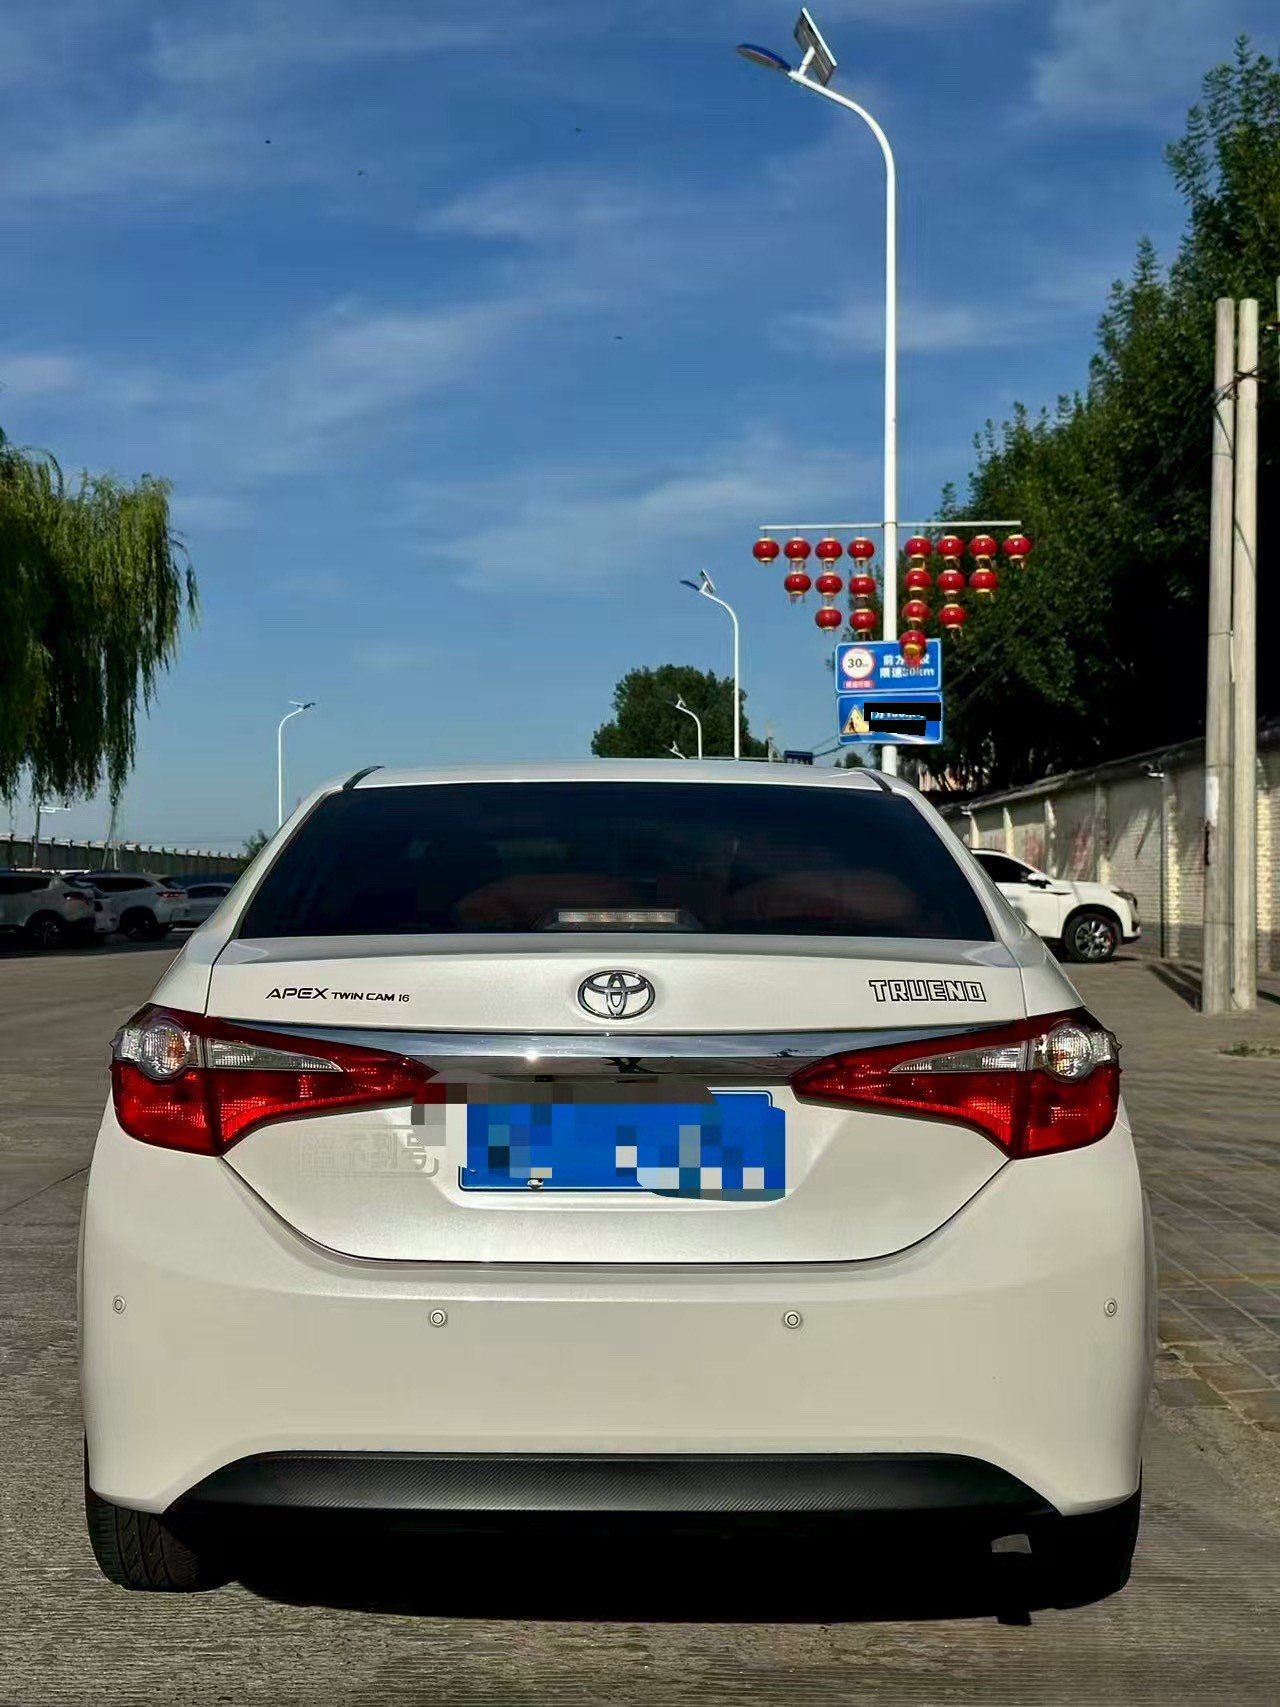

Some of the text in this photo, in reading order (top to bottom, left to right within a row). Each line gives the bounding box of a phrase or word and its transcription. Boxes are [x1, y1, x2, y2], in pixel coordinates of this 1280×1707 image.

[265, 988, 329, 999] APEX
[332, 992, 363, 1000] TWIN
[366, 993, 395, 1001] CAM
[868, 979, 987, 1002] TRUENO
